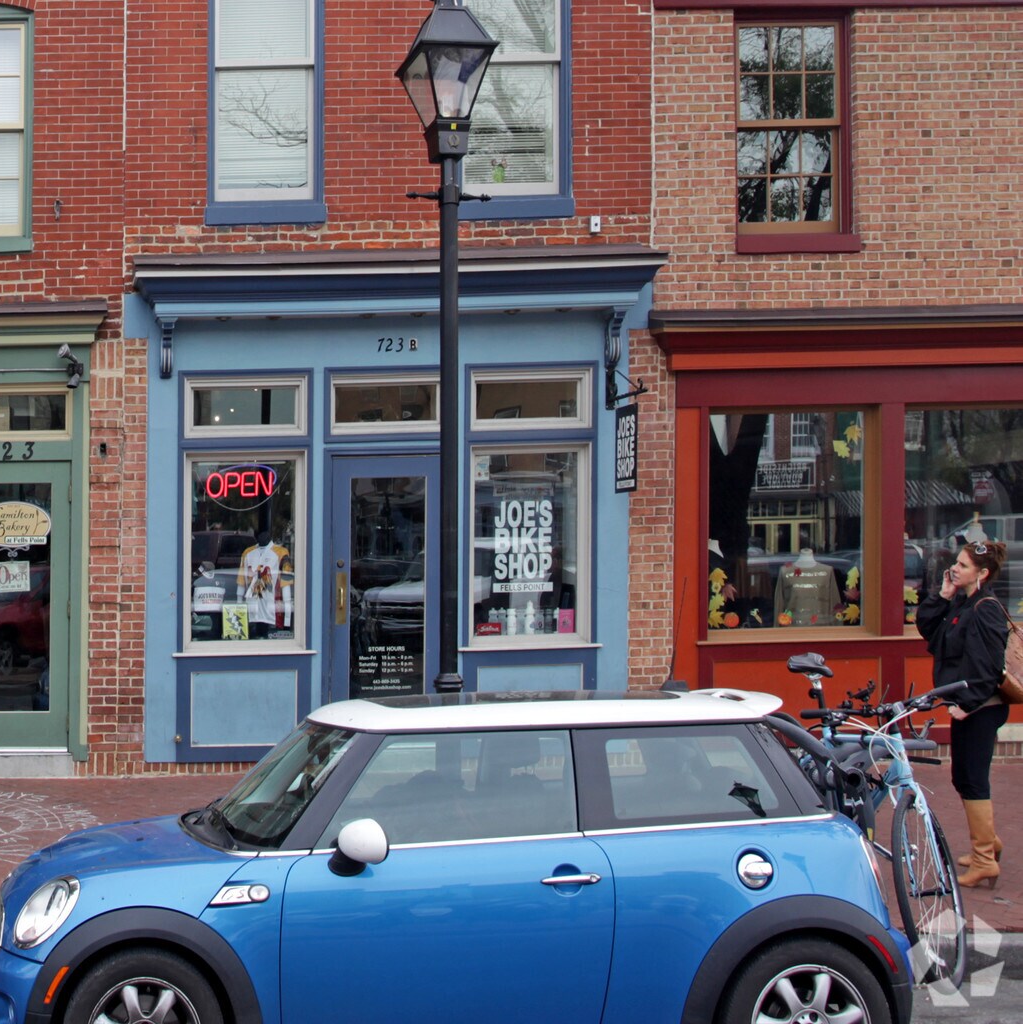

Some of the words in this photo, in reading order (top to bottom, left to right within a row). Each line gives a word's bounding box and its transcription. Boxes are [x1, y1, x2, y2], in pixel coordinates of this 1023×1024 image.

[618, 414, 635, 438] JOE'S
[618, 436, 635, 458] BIKE
[617, 457, 635, 479] SHOP
[206, 471, 273, 498] OPEN
[495, 500, 553, 527] JOE'S
[495, 527, 553, 553] BIKE
[494, 553, 553, 579] SHOP
